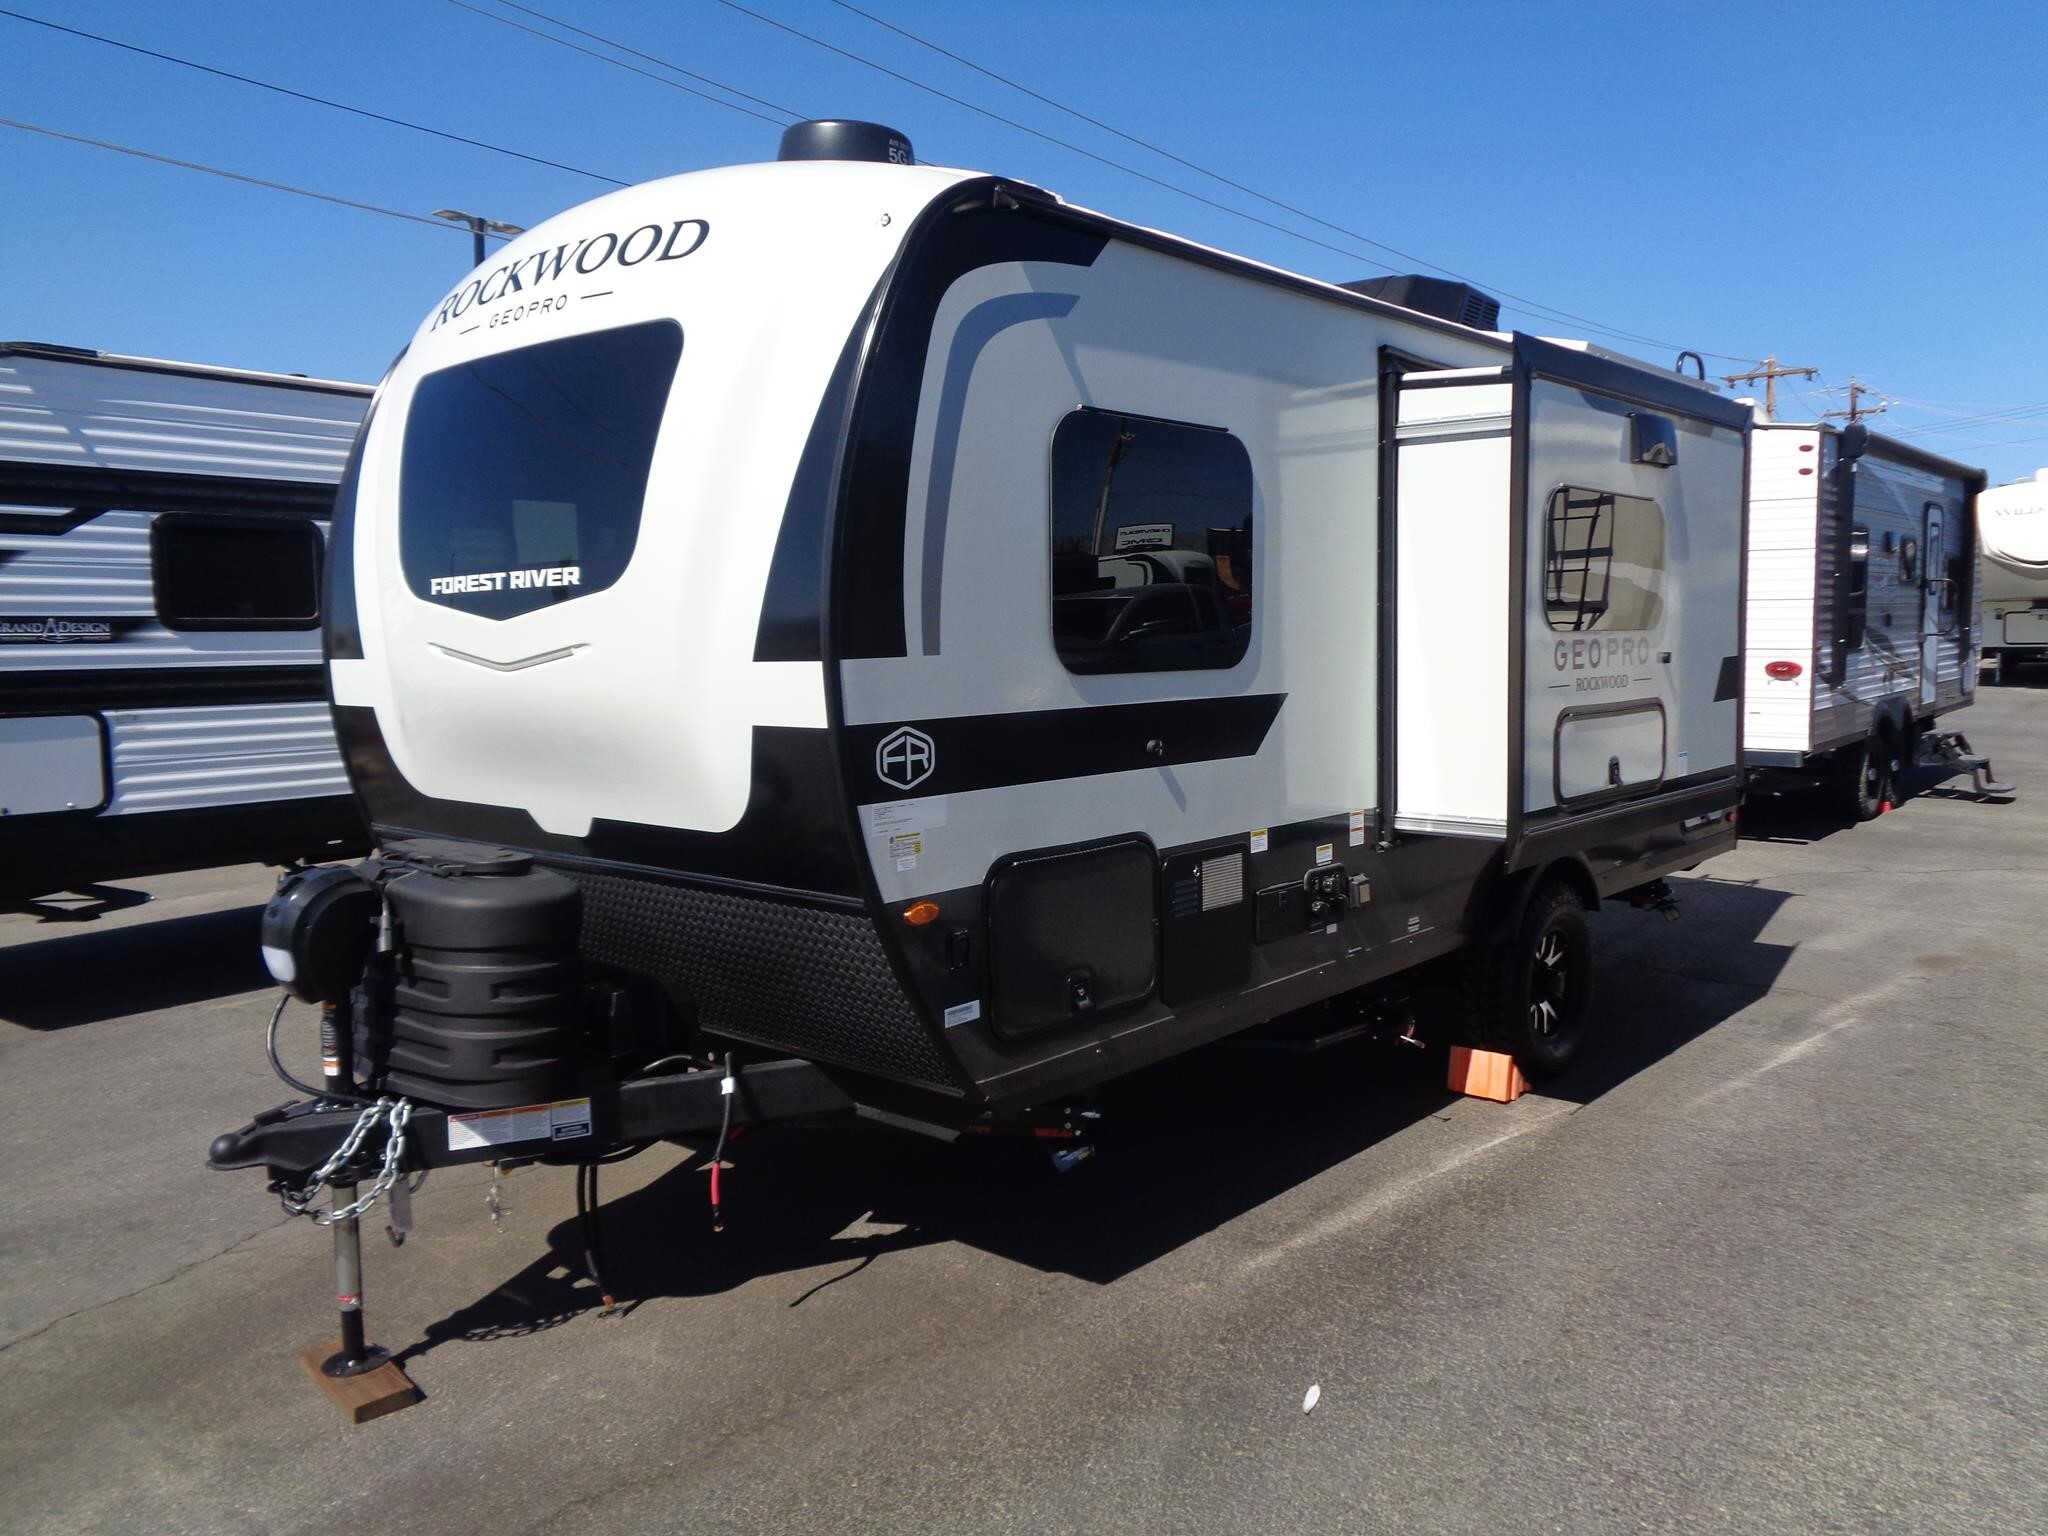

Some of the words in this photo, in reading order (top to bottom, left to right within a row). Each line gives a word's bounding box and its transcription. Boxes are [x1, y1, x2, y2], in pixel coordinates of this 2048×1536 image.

[429, 219, 710, 332] ROCKWOOD
[489, 295, 568, 328] GEOPRO
[430, 572, 507, 596] FOREST
[509, 566, 581, 589] RIVER
[59, 621, 110, 633] DESIGN
[1575, 674, 1629, 692] ROCKWOOD
